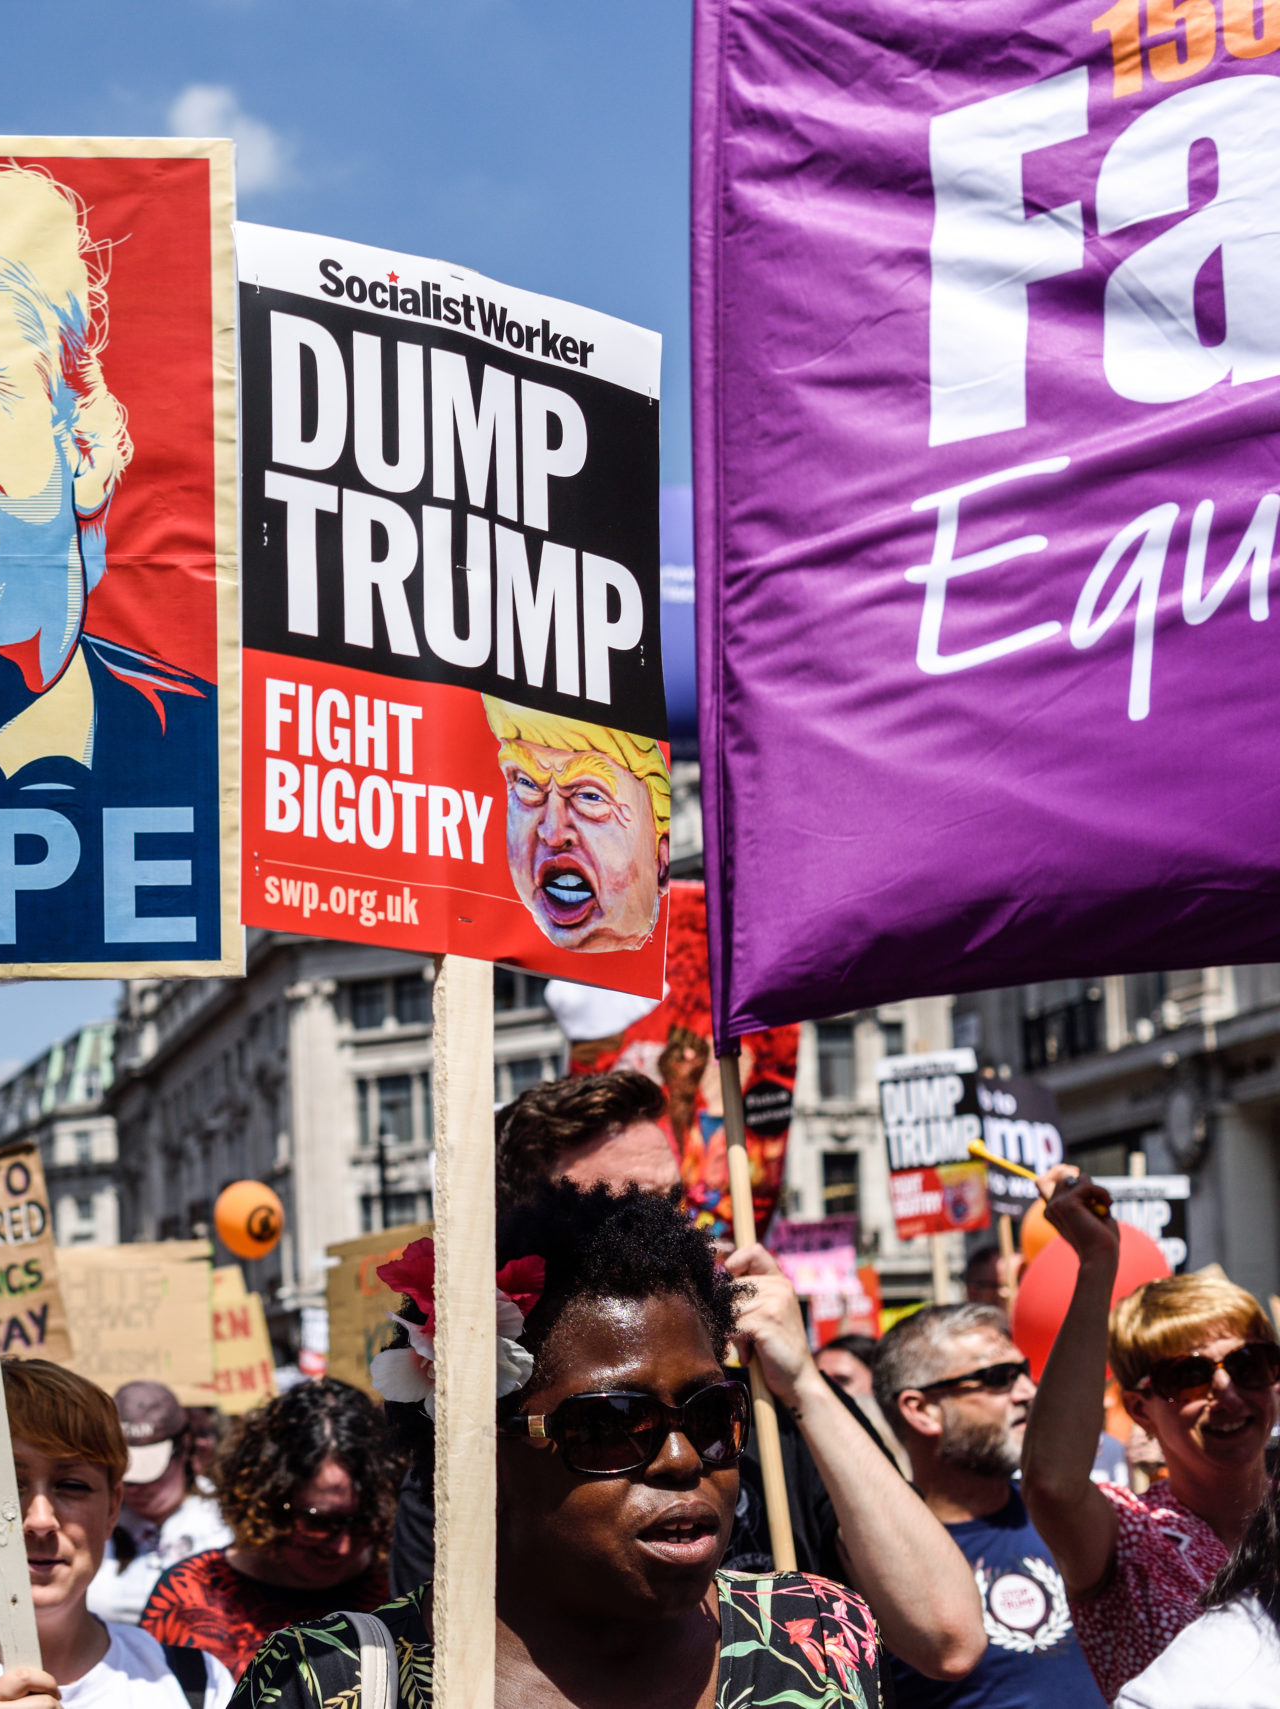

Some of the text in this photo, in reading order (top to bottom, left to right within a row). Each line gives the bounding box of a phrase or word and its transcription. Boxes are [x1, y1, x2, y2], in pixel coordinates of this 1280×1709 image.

[270, 309, 588, 532] DUMP
[264, 470, 644, 705] TRUMP
[265, 677, 423, 775] FIGHT
[265, 757, 493, 864] BIGOTRY
[264, 874, 419, 927] swp.org.uk
[883, 1075, 965, 1123] DUMP
[885, 1114, 983, 1170] TRUMP
